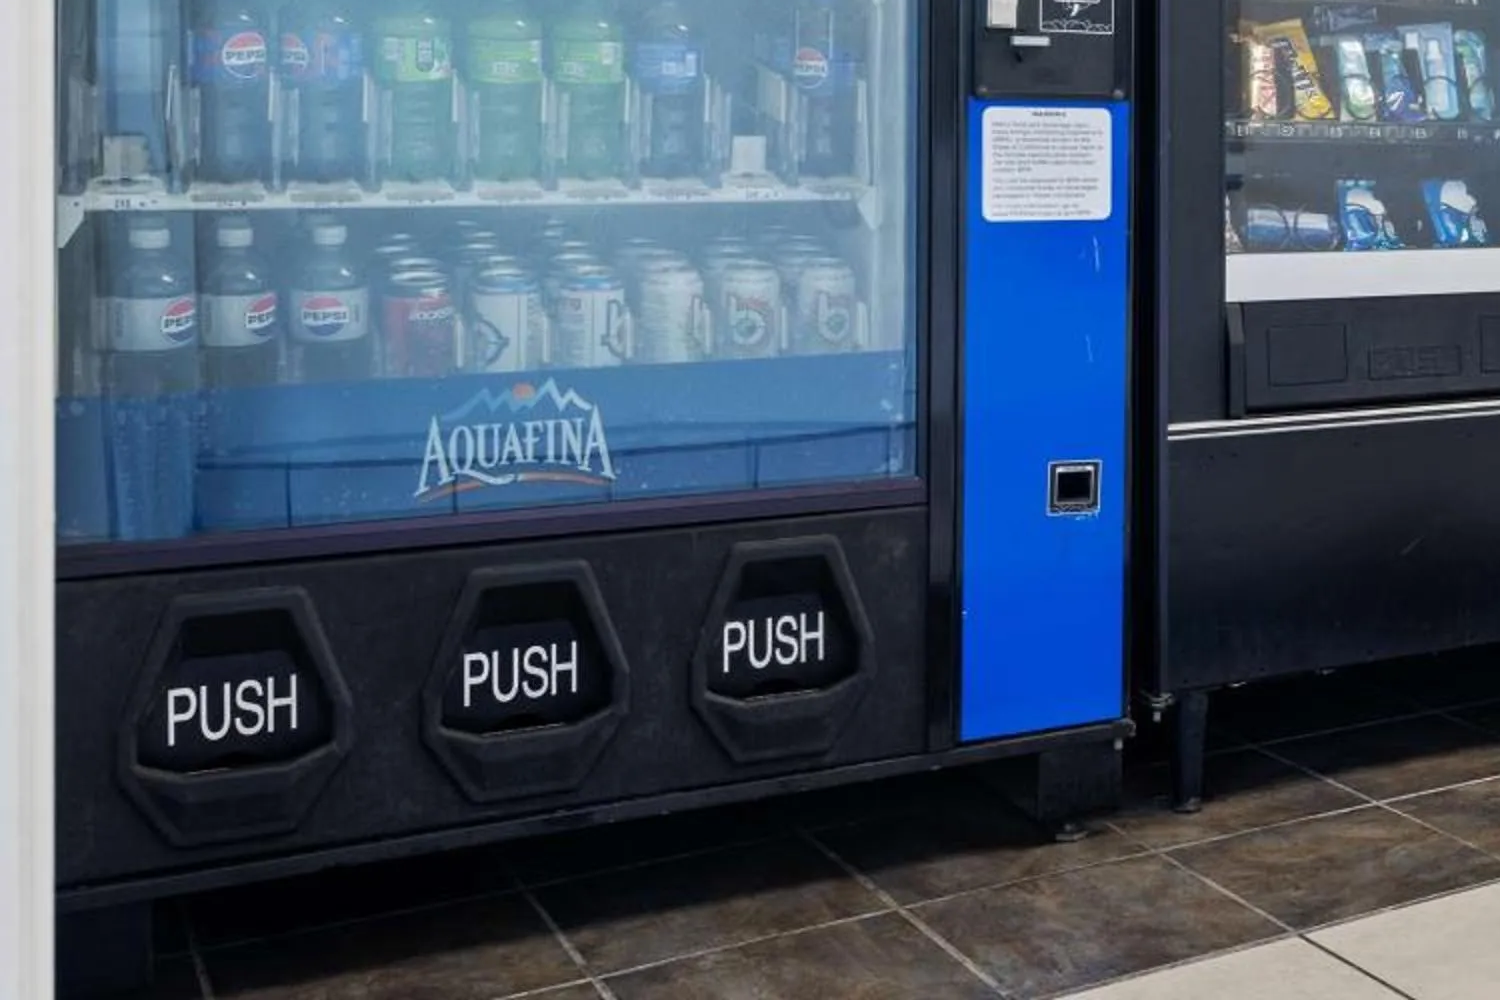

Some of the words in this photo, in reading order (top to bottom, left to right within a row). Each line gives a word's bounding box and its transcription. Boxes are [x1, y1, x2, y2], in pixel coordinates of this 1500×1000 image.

[302, 310, 348, 321] PEPSI
[416, 404, 616, 497] AQUAFINA
[462, 640, 578, 708] PUSH
[723, 610, 825, 673] PUSH
[165, 673, 299, 747] PUSH
